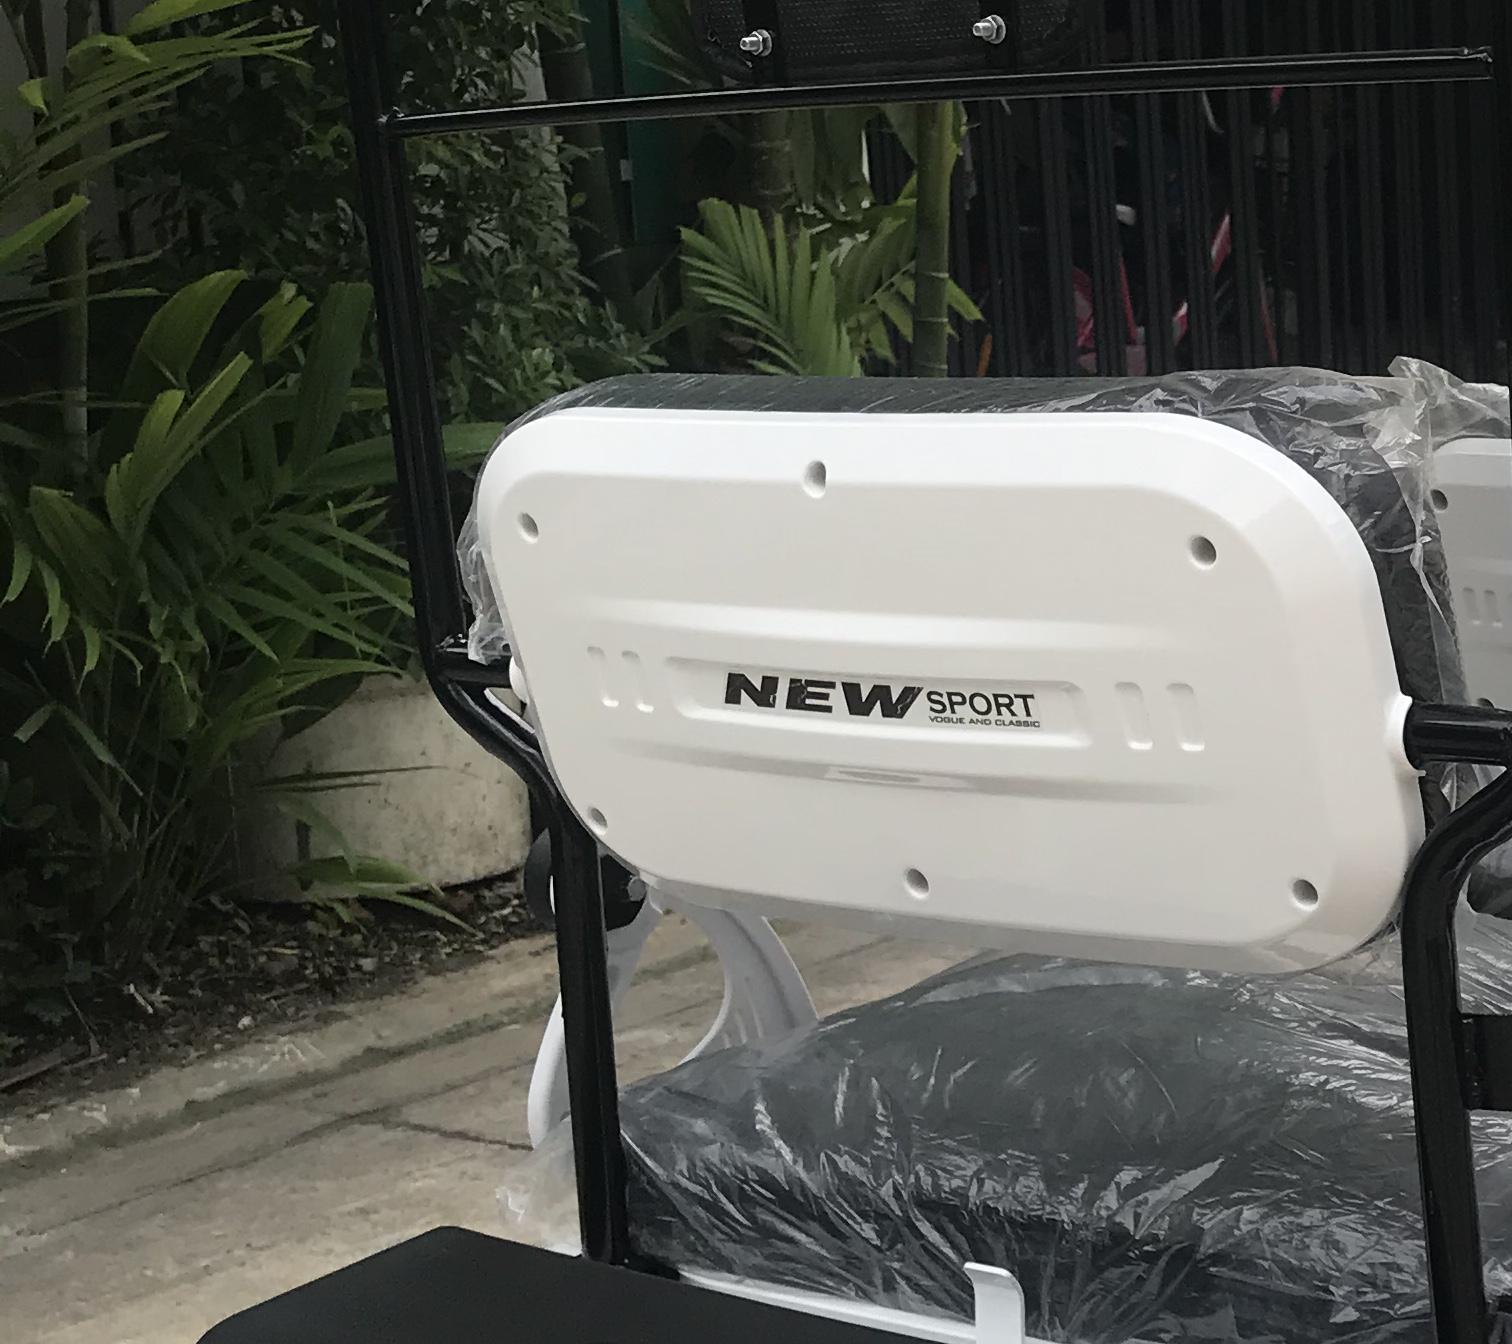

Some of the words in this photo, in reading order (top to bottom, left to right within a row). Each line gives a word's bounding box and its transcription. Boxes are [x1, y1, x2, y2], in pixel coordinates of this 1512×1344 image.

[724, 672, 924, 719] NEW
[926, 690, 1036, 718] SPORT
[928, 715, 966, 725] VOGUE
[968, 717, 992, 726] AND
[994, 718, 1041, 729] CLASSIC
